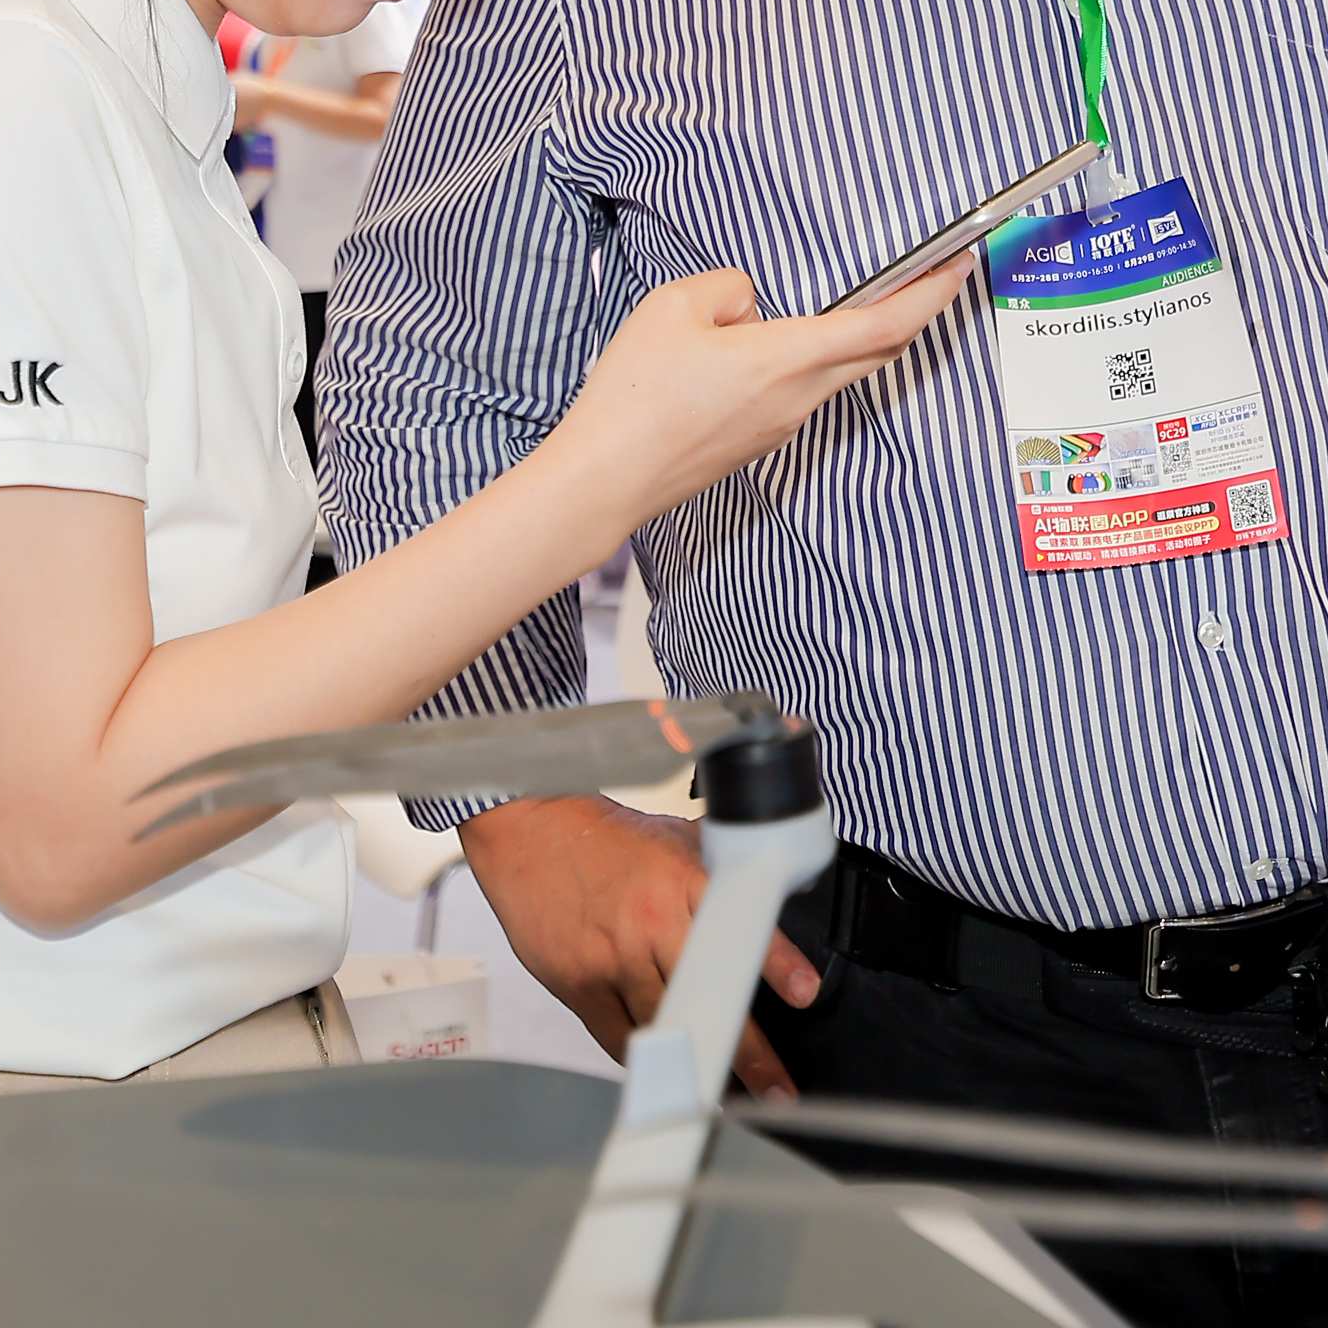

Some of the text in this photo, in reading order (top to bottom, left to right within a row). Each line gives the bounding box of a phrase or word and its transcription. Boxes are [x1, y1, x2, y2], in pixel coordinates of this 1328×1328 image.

[1025, 242, 1072, 263] AGIC
[1063, 265, 1113, 280] 09:00-16:30
[1162, 261, 1215, 287] AUDIENCE
[1025, 291, 1212, 337] skordilis.stylianos
[1159, 427, 1186, 441] 9C29
